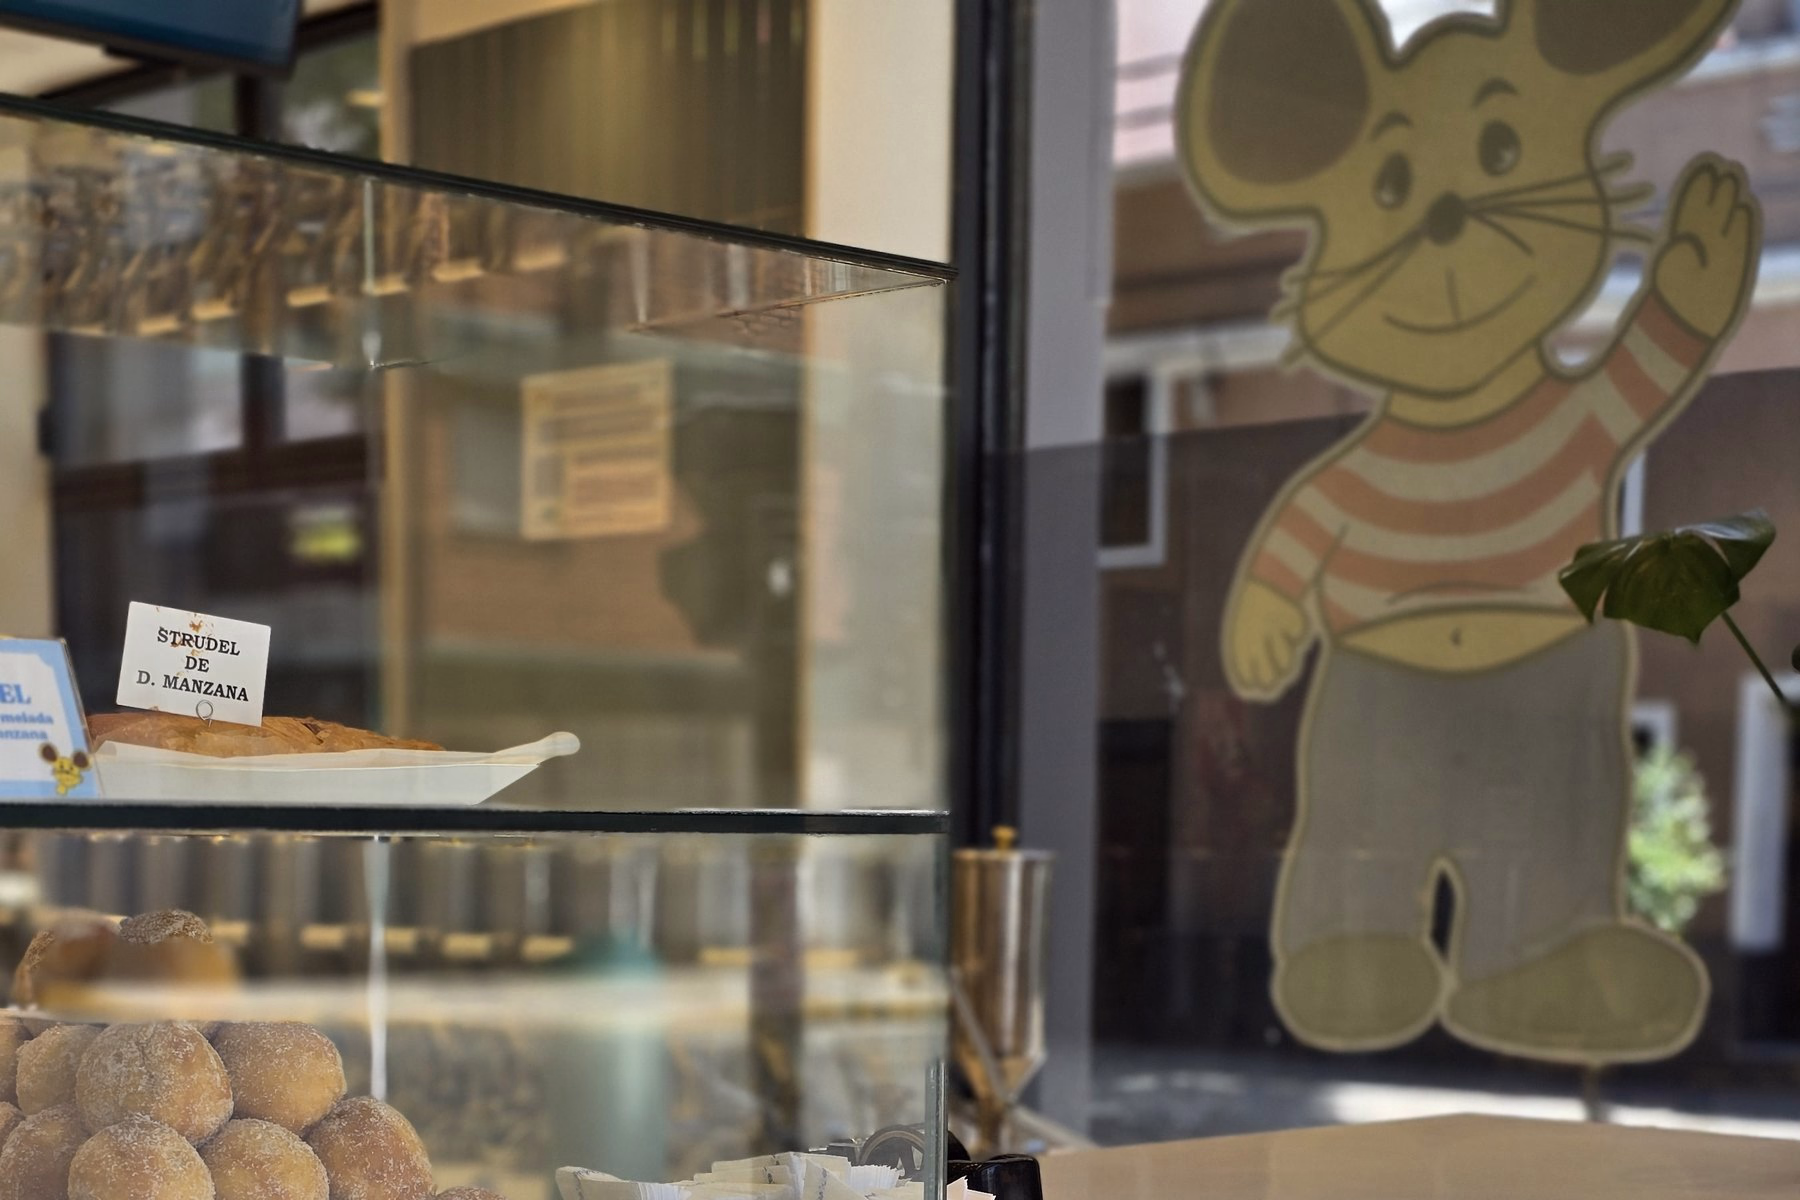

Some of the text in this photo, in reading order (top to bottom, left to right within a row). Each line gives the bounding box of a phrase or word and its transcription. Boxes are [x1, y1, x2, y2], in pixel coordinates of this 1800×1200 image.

[157, 627, 240, 656] STRUDEL
[185, 656, 210, 673] DE
[136, 670, 249, 702] D. MANZANA
[0, 711, 54, 725] melada
